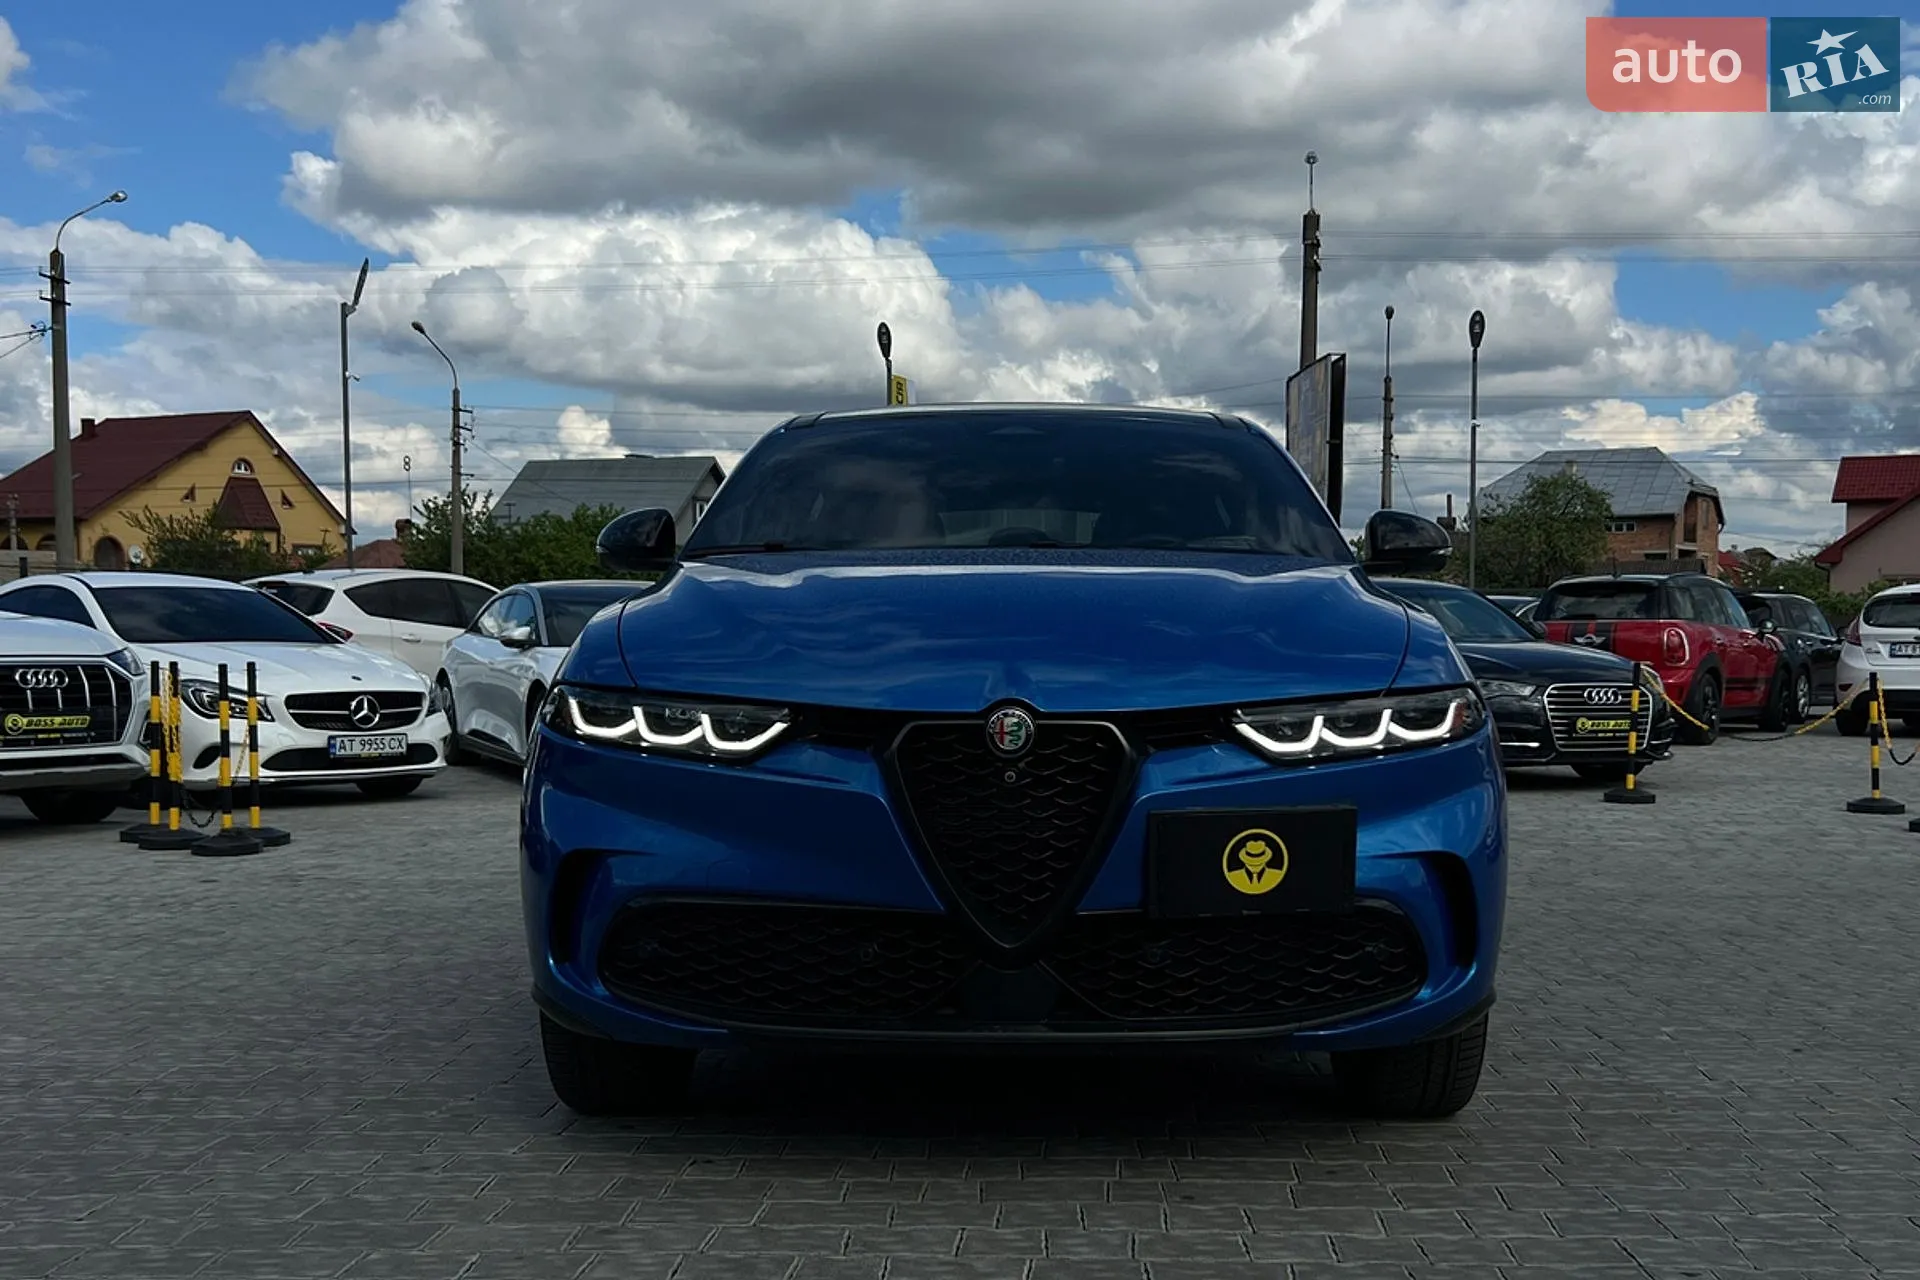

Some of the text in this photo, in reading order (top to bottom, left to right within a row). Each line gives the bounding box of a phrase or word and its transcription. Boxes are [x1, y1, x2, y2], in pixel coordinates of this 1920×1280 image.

[25, 717, 88, 728] BOSS AUTO
[338, 739, 355, 752] AT
[359, 738, 386, 751] 9955
[388, 737, 405, 750] CX
